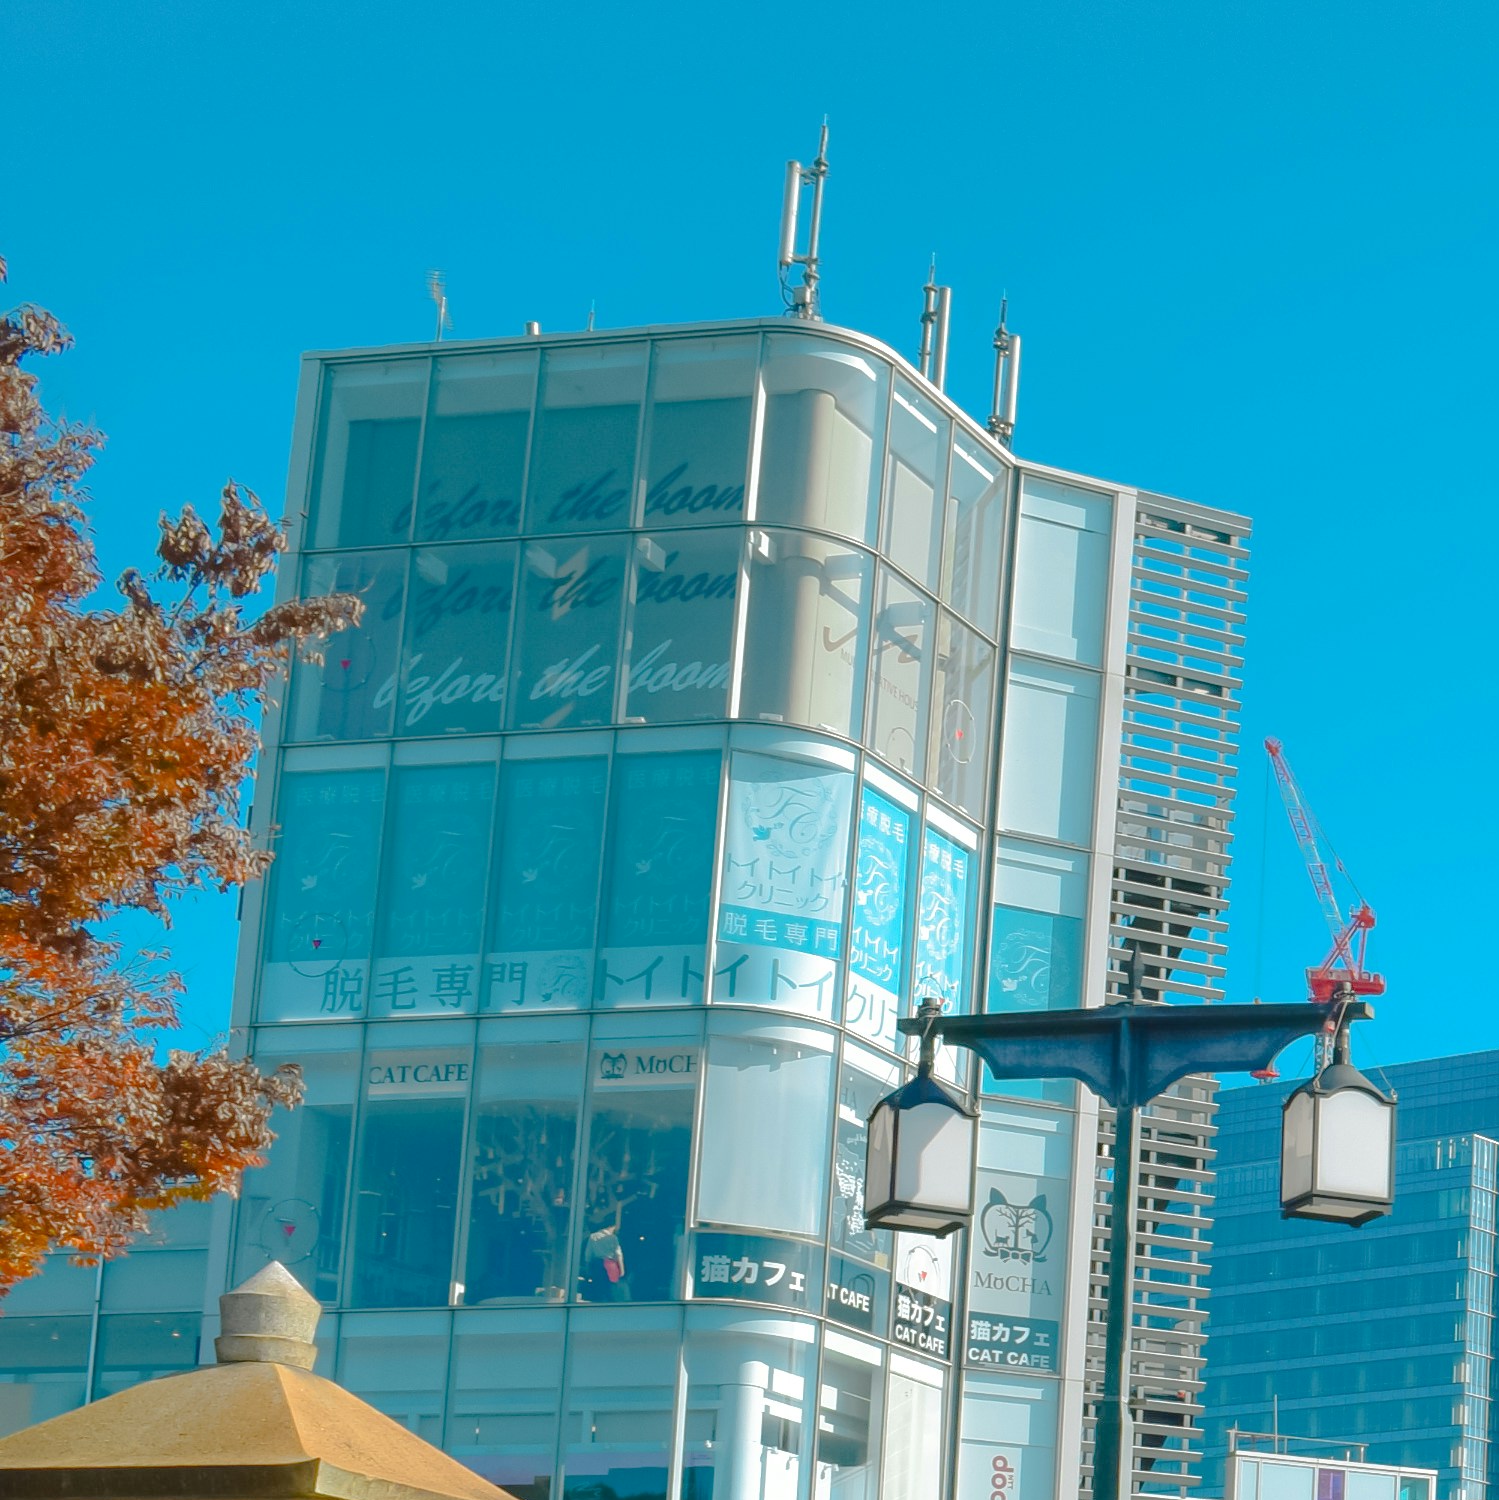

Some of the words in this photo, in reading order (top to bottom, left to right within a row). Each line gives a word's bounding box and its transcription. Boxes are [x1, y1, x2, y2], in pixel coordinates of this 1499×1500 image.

[723, 911, 839, 952] 脱毛専門
[320, 960, 529, 1014] 脱毛専門
[413, 1062, 469, 1084] CAFE
[701, 1255, 805, 1293] 猫カフェ
[840, 1288, 870, 1312] CAFE
[897, 1295, 946, 1332] 猫カフェ
[895, 1324, 918, 1345] CAT
[918, 1329, 945, 1355] CAFE
[970, 1319, 1050, 1347] 猫カフェ
[968, 1347, 1003, 1363] CAT
[1006, 1351, 1050, 1369] CAFE
